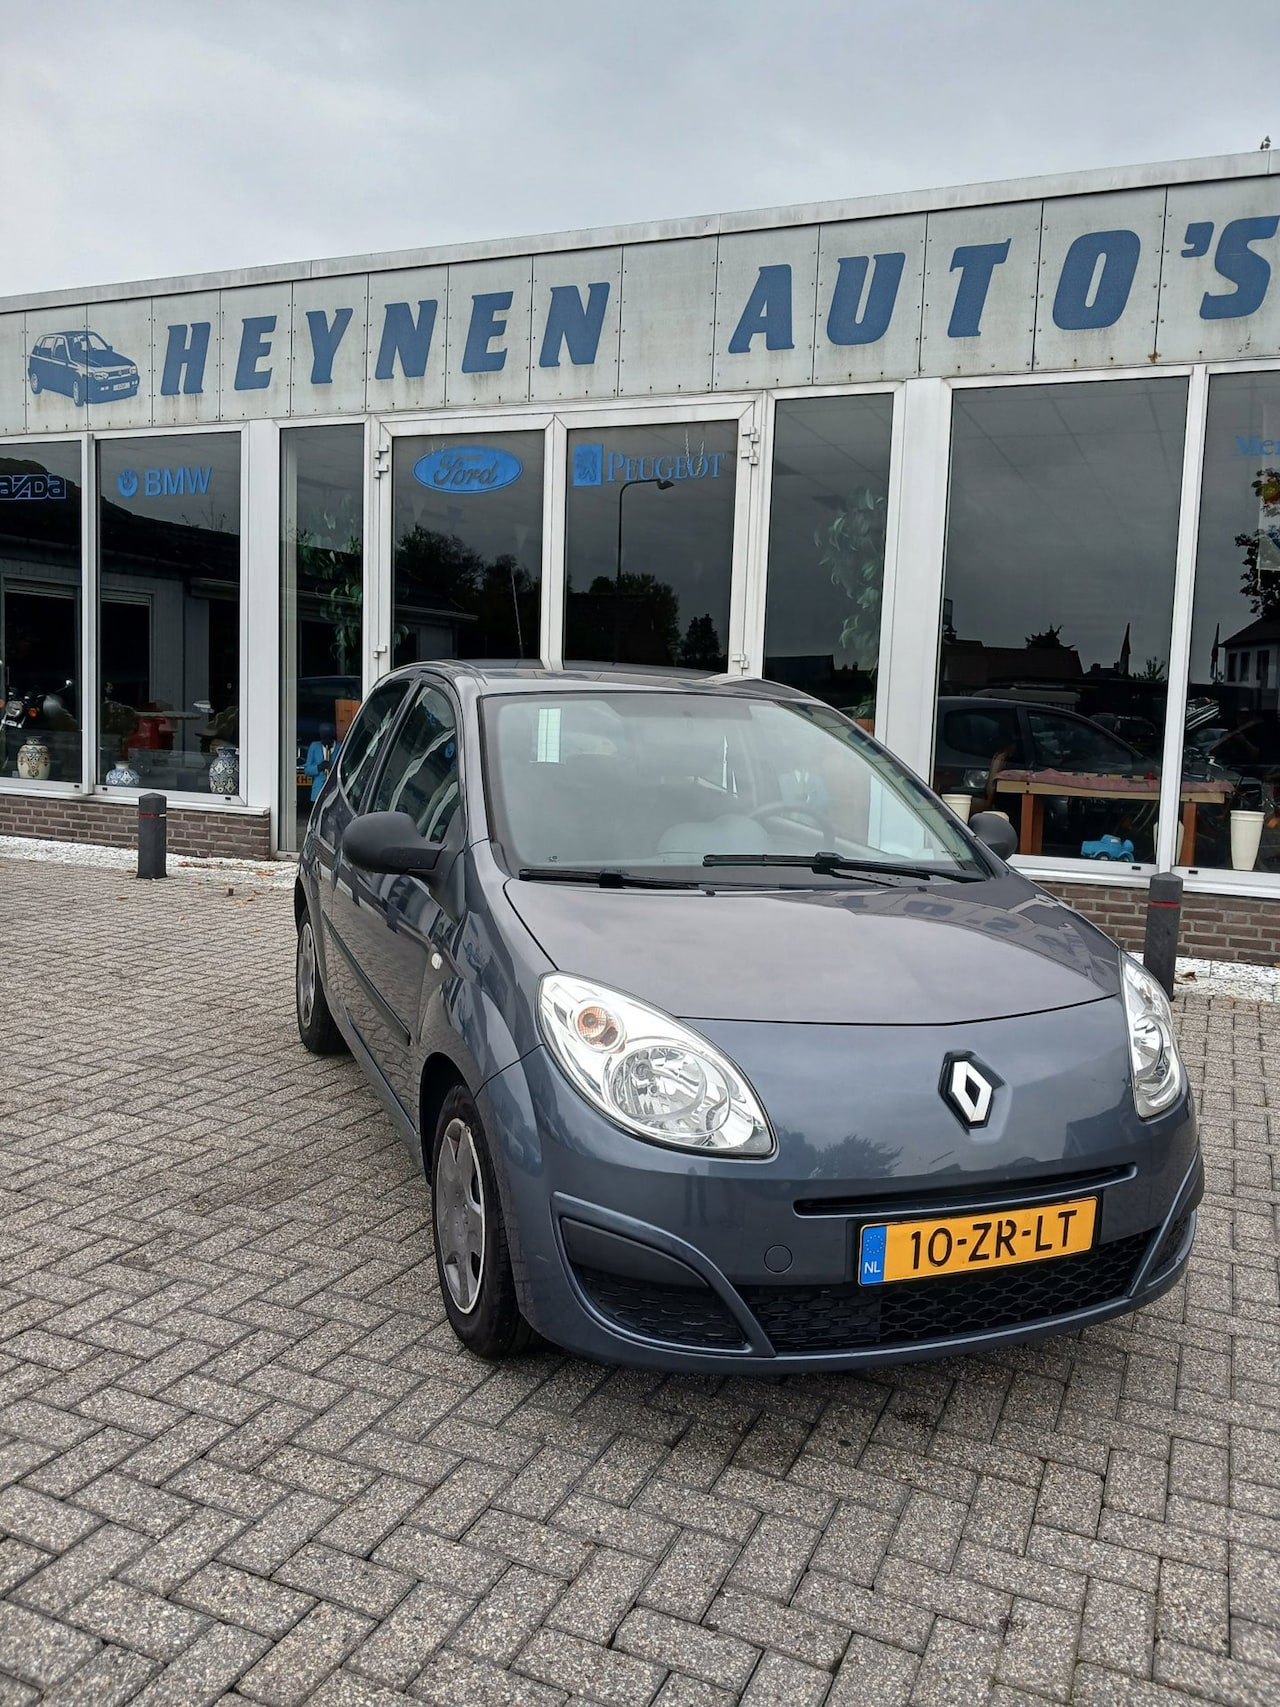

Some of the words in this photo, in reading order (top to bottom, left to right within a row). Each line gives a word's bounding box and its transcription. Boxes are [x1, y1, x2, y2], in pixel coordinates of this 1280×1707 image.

[161, 282, 610, 396] HEYNEN
[728, 215, 1280, 353] AUTO'S
[145, 466, 212, 496] BMW
[433, 455, 499, 485] Ford
[608, 451, 724, 482] PEUGEOT
[864, 1261, 881, 1275] NL
[911, 1210, 1078, 1270] 10-ZR-LT
